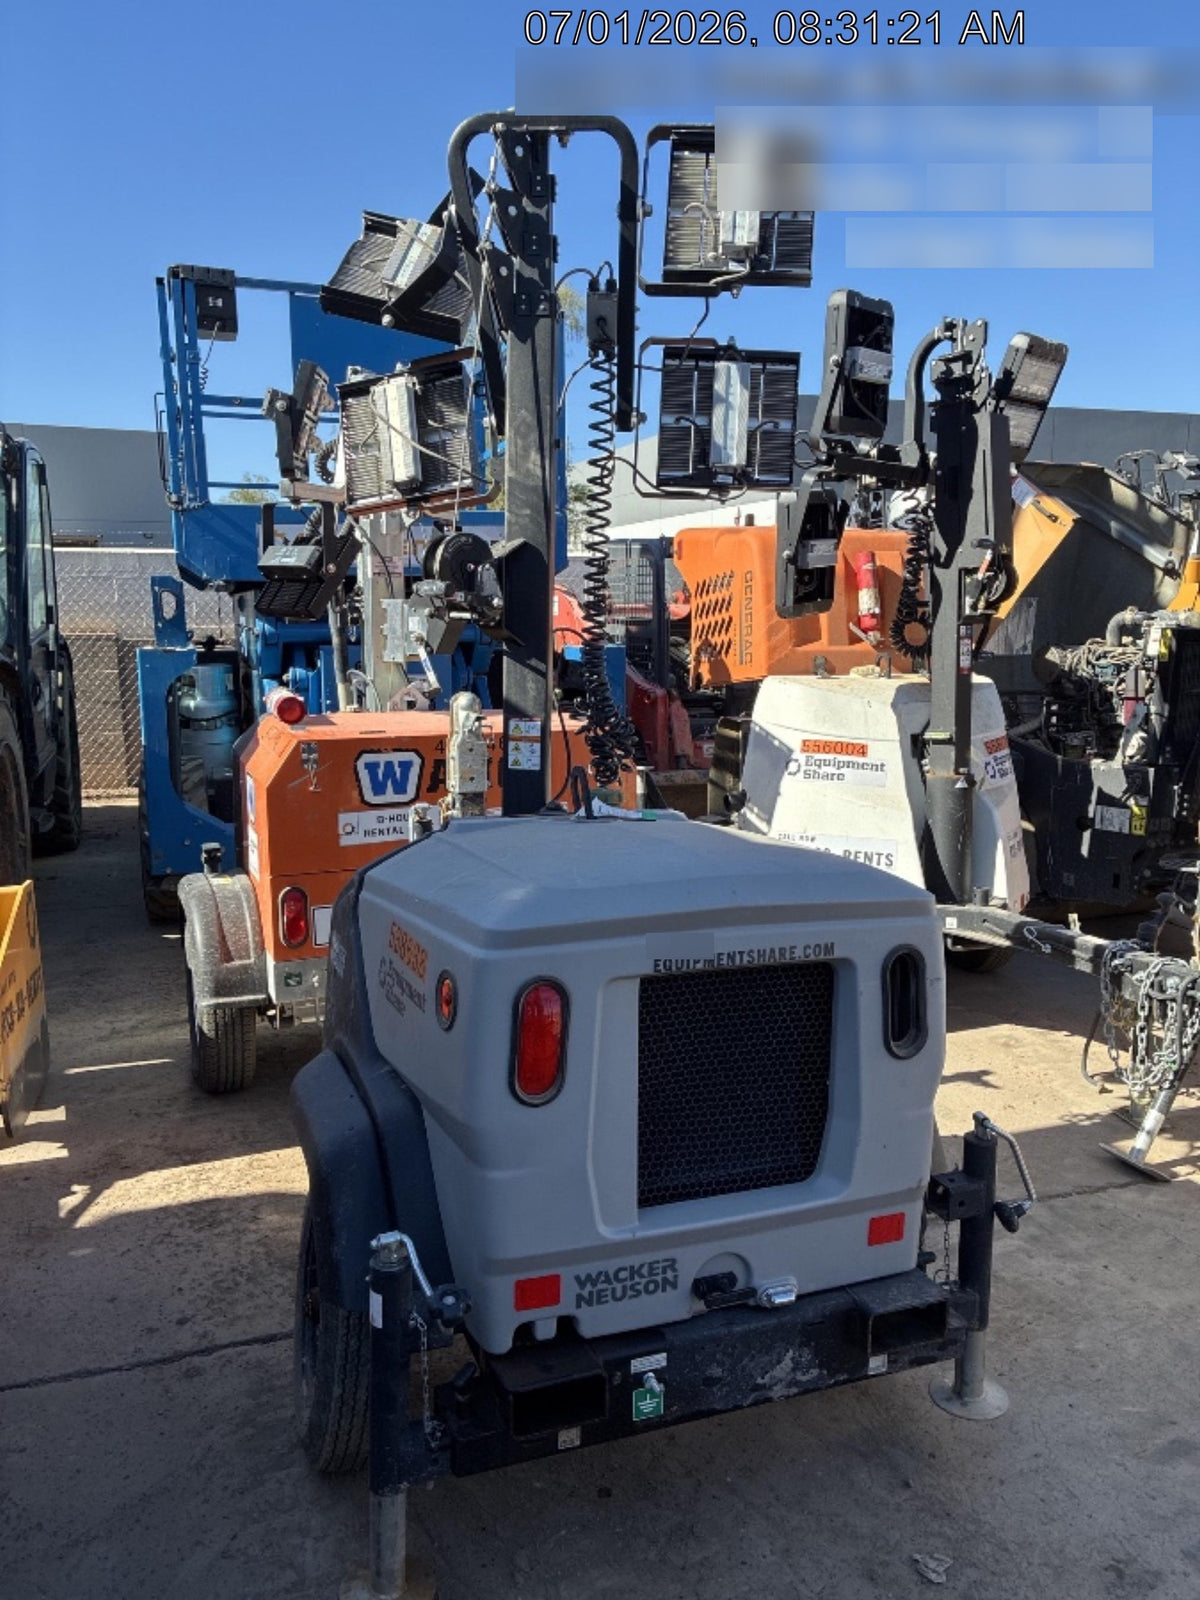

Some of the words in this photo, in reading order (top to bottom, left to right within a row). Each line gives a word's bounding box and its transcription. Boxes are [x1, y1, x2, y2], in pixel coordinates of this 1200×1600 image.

[744, 570, 753, 666] GENERAC
[801, 740, 867, 757] 556004
[803, 769, 846, 781] Share
[804, 756, 886, 772] Equipment
[574, 1258, 678, 1291] WACKER
[575, 1274, 679, 1309] NEUSON
